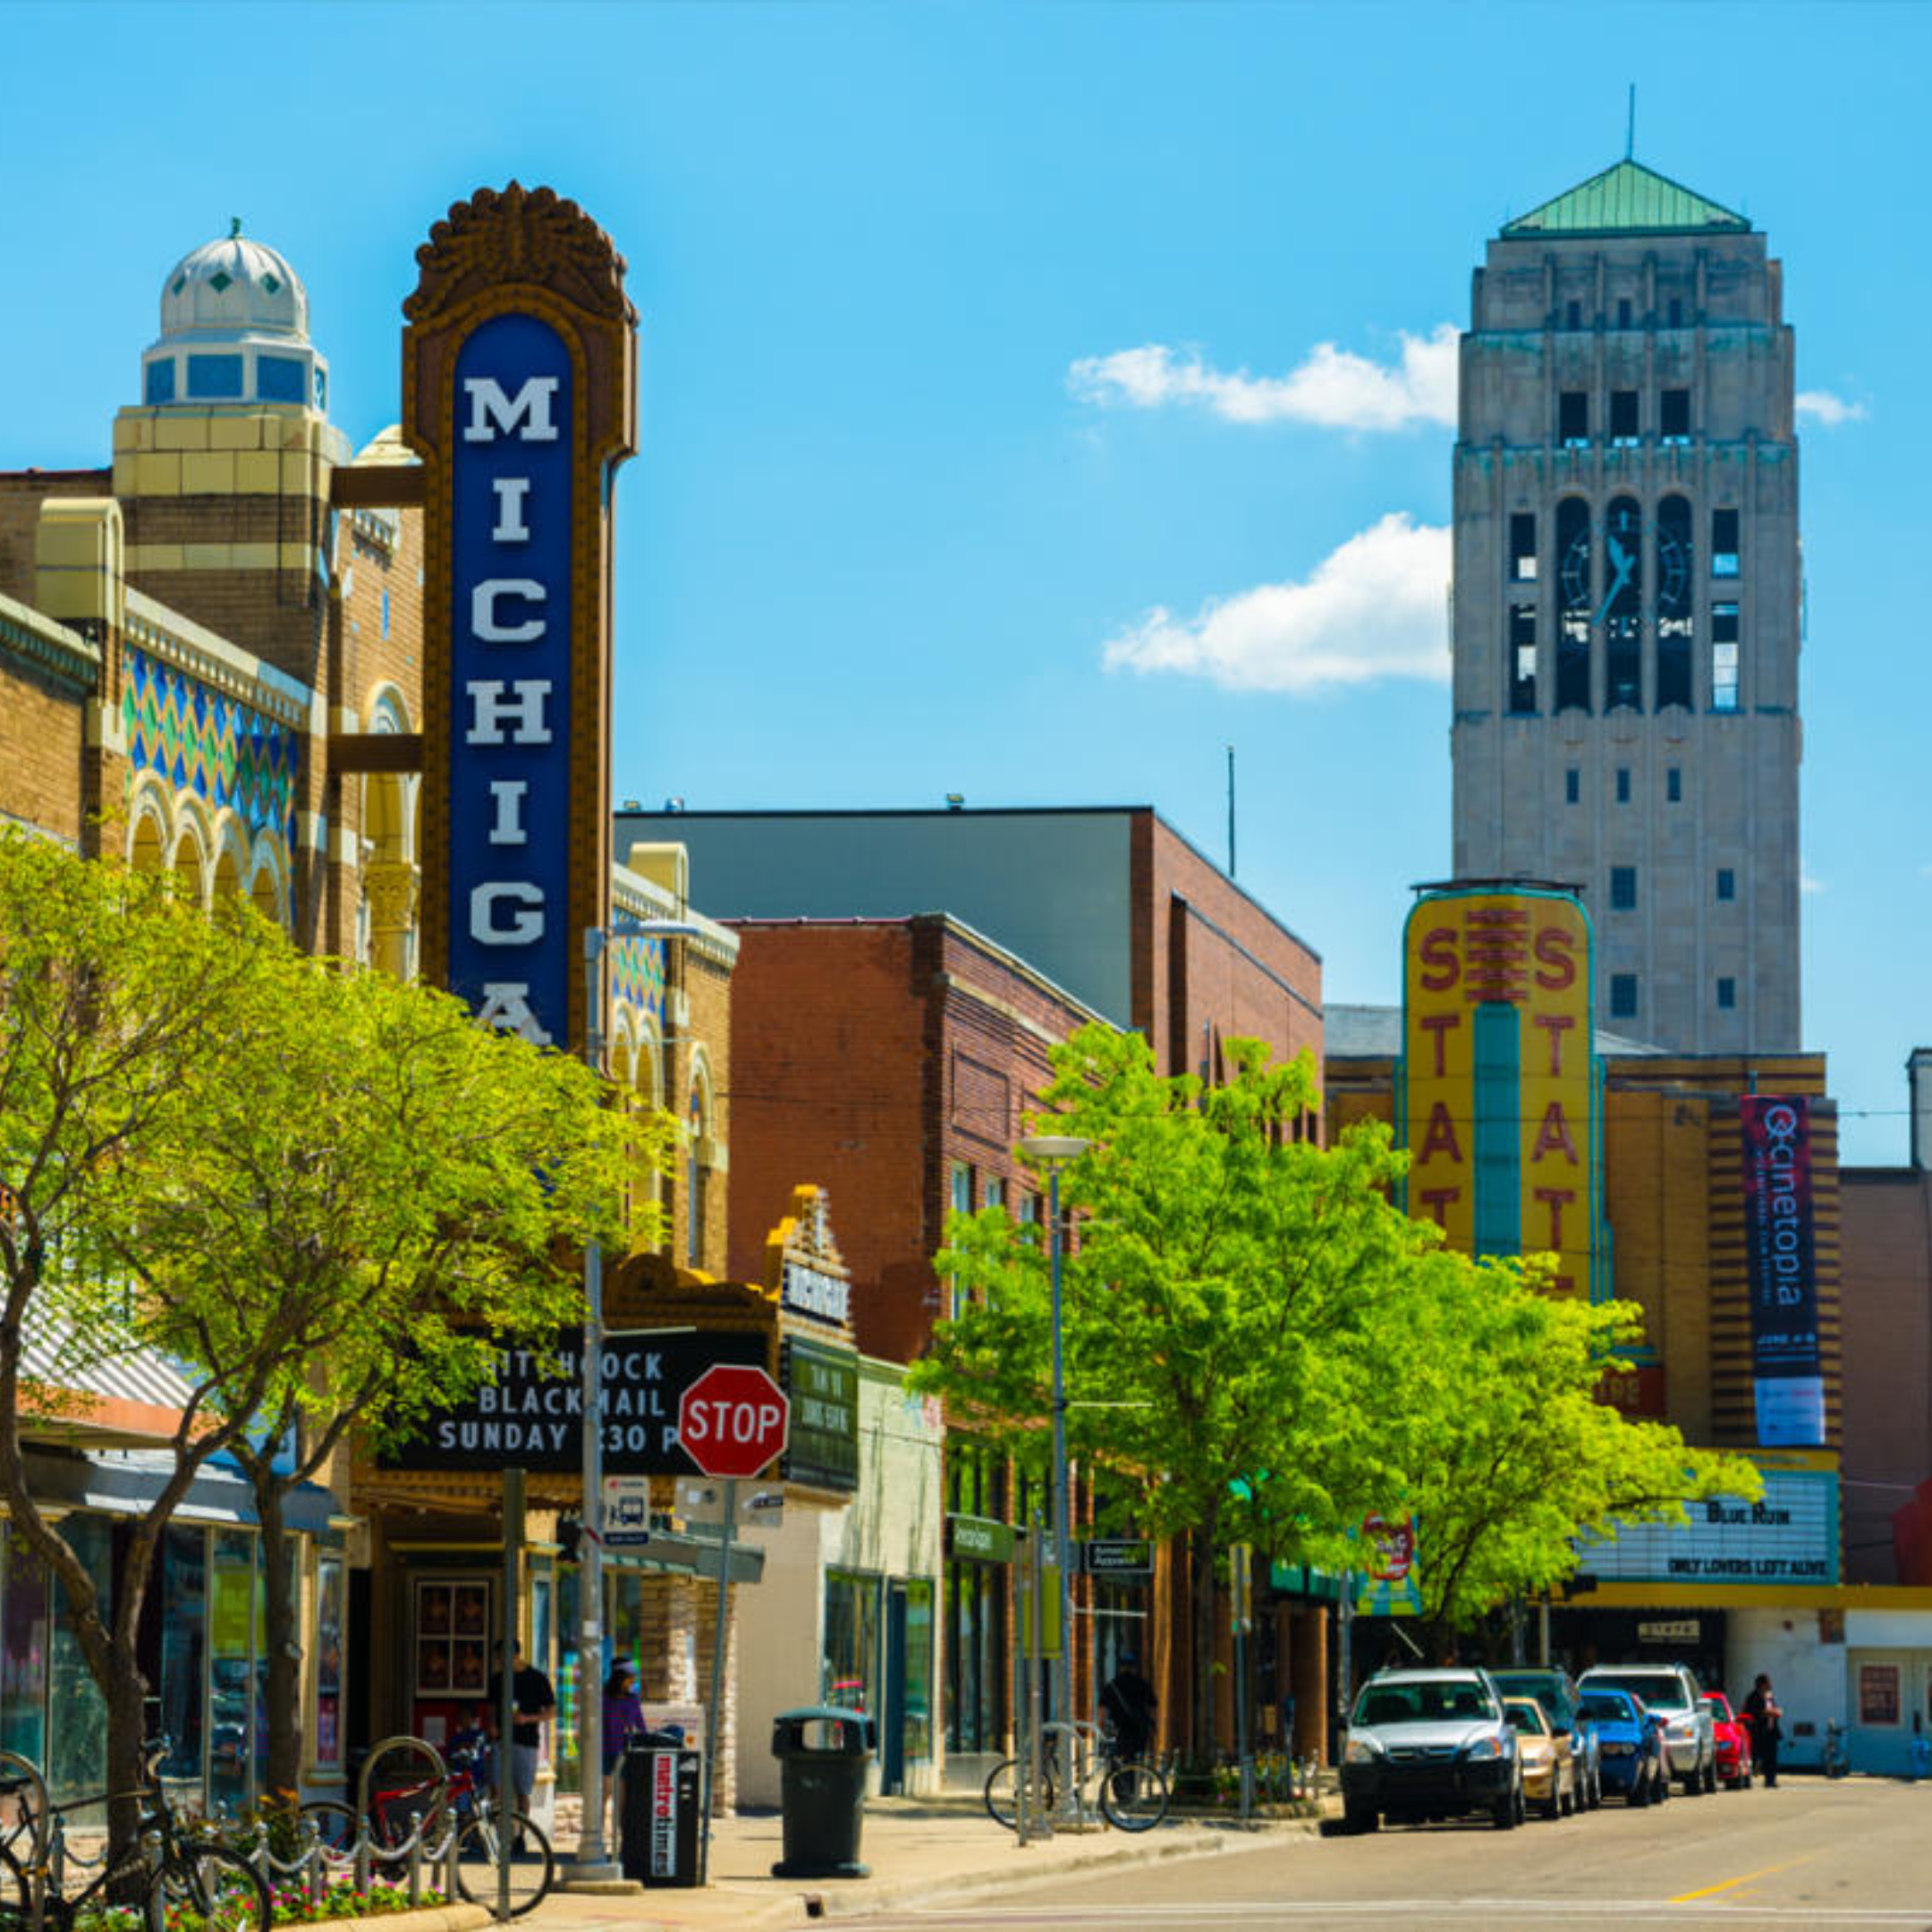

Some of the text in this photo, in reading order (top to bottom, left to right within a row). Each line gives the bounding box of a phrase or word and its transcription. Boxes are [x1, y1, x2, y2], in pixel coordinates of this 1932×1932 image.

[464, 377, 559, 1045] MICHIGA
[1419, 927, 1462, 1247] STAT
[1531, 927, 1578, 1290] STAT
[1771, 1145, 1801, 1306] cinetopia
[439, 1421, 681, 1454] SUNDAY :30 P
[483, 1351, 663, 1380] ITHOCK
[688, 1400, 781, 1444] STOP
